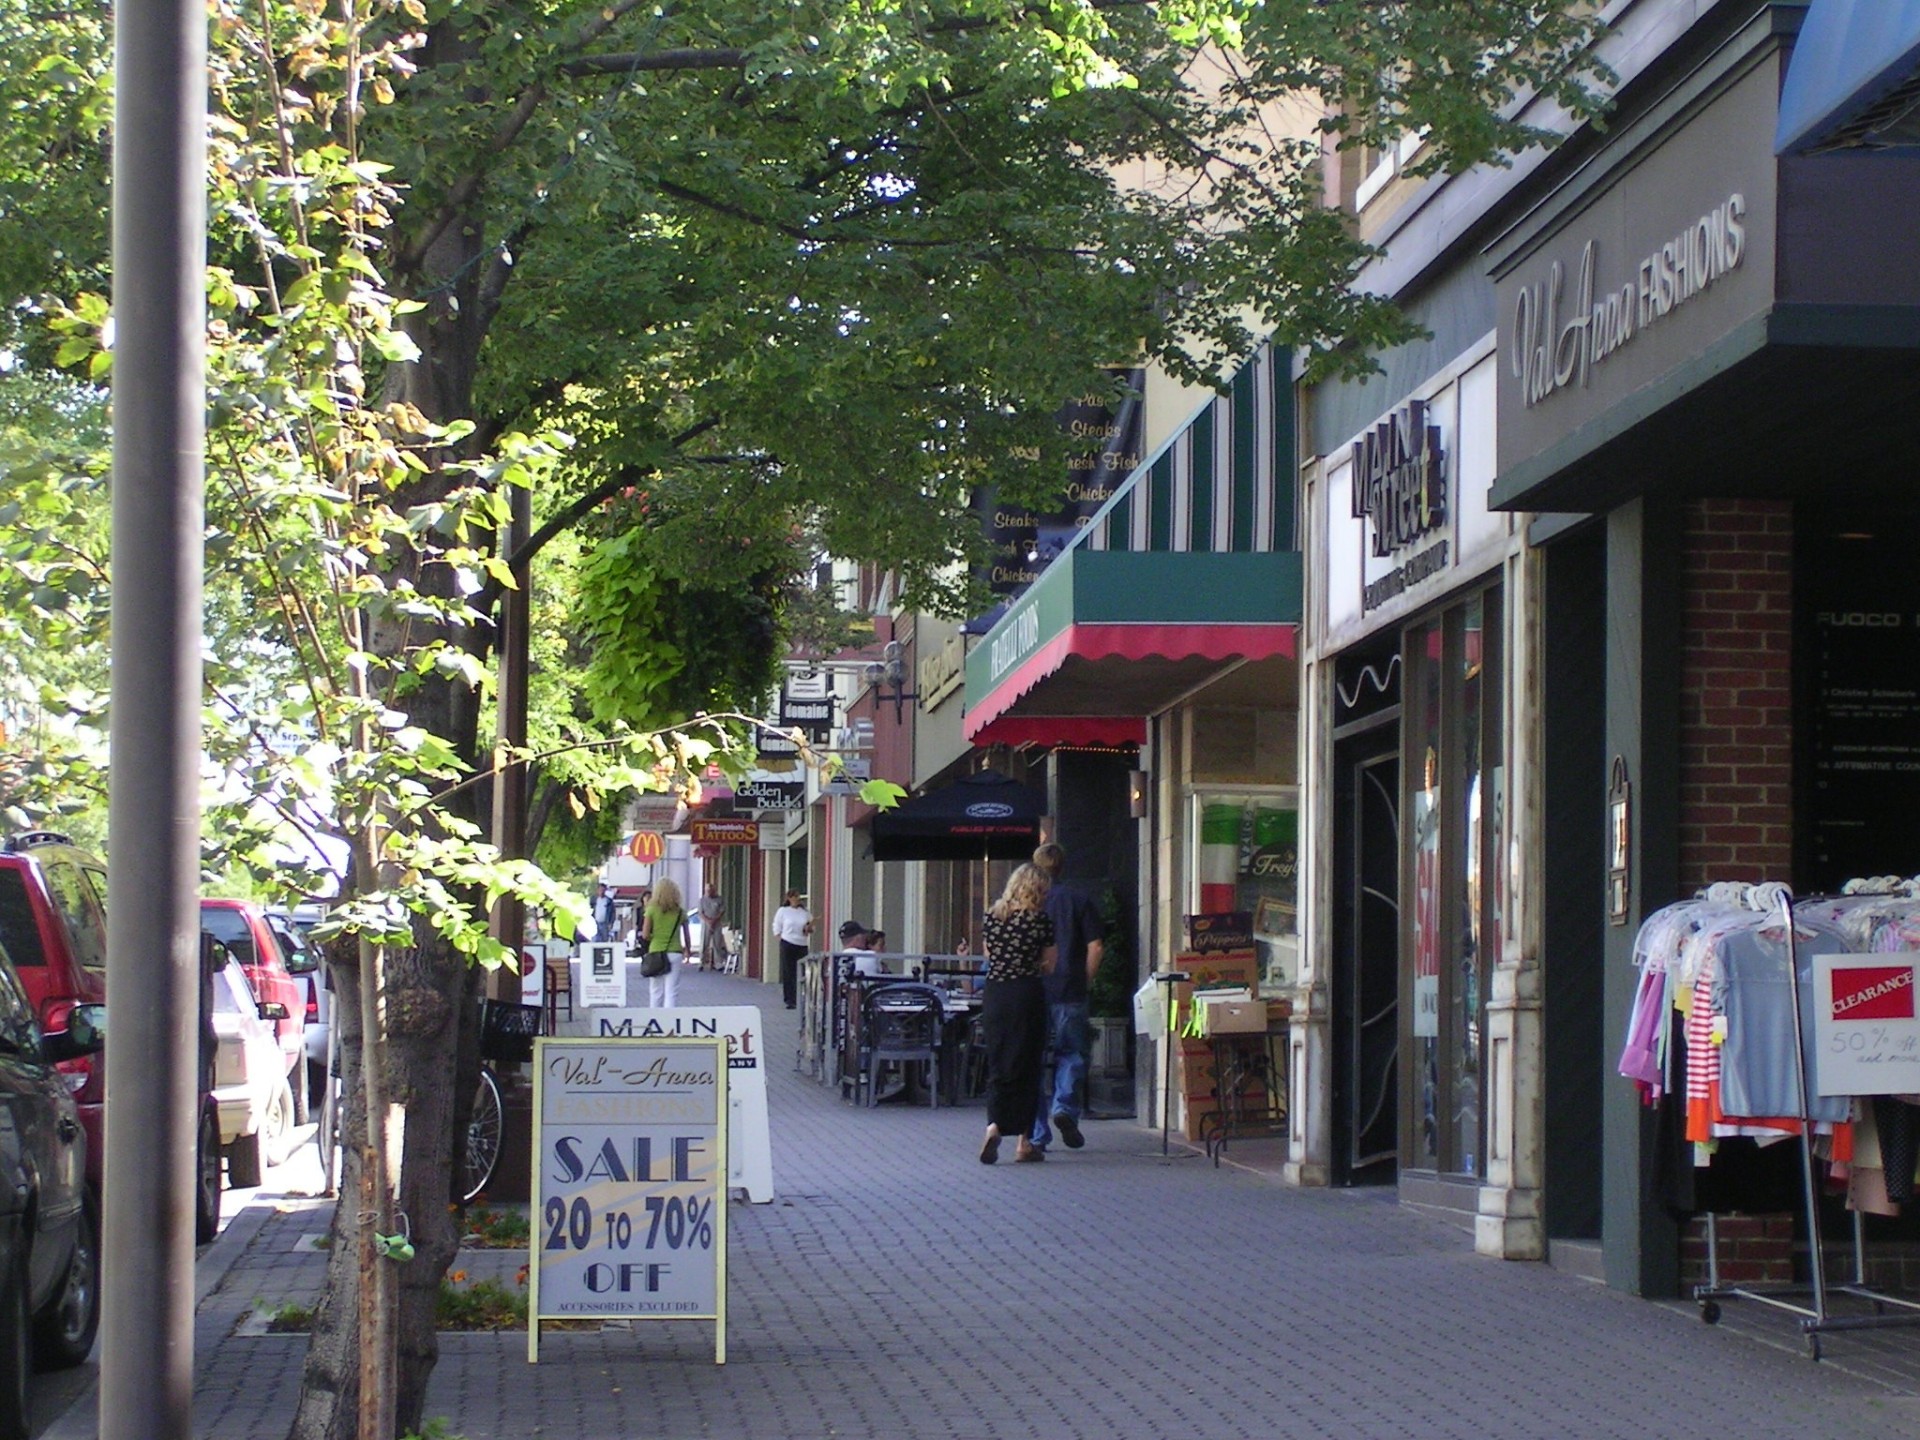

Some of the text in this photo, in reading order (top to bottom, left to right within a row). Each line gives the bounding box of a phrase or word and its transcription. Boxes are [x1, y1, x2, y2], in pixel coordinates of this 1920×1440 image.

[1513, 193, 1746, 409] Val Anna FASHIONS
[1071, 419, 1122, 439] Steaks
[1101, 451, 1139, 471] Fish
[1351, 400, 1424, 518] MAIN
[1066, 482, 1114, 502] Chicke
[994, 511, 1040, 528] Steaks
[785, 703, 829, 719] domaine
[737, 783, 782, 801] Golden
[1832, 971, 1913, 1014] CLEARANCE
[599, 1018, 717, 1037] MAIN
[556, 1099, 707, 1118] FASHIONS
[552, 1136, 707, 1184] SALE
[545, 1196, 593, 1251] 20
[645, 1194, 713, 1251] 70%
[583, 1262, 673, 1293] OFF
[557, 1301, 700, 1313] ACCESSORIES EXCLUDED
